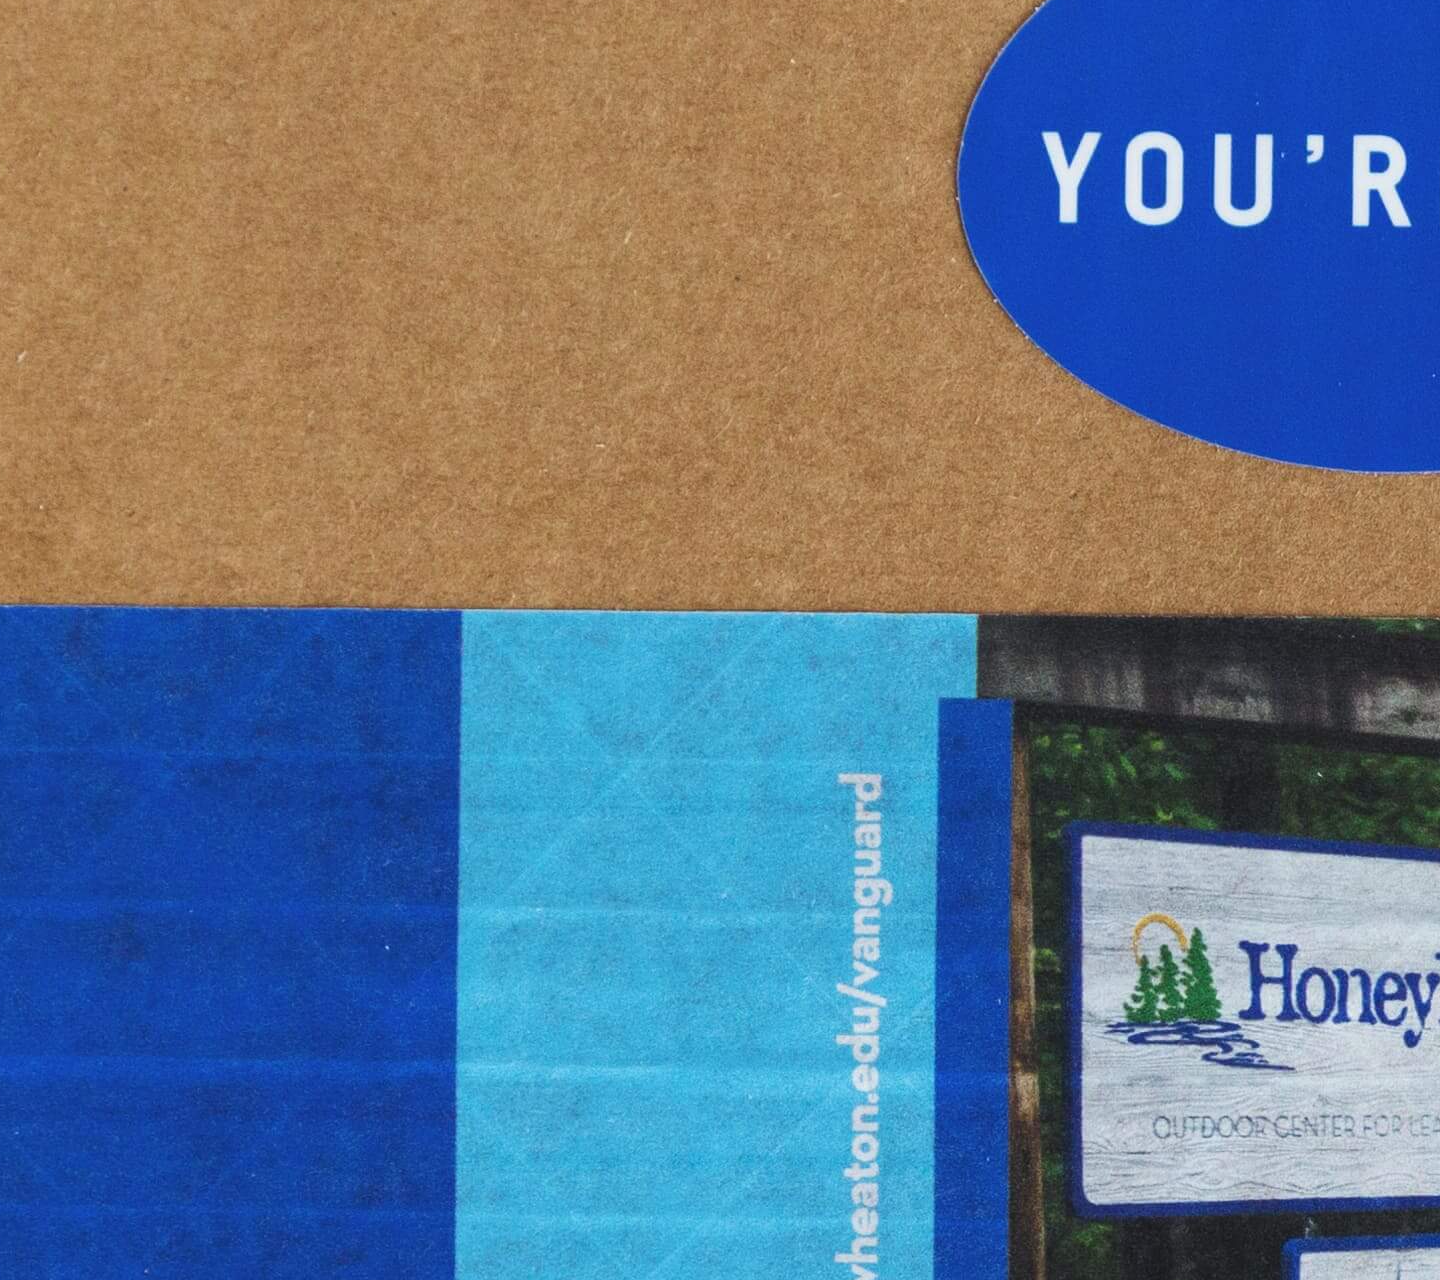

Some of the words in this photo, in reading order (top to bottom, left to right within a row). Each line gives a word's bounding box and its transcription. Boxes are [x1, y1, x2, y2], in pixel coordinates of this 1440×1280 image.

[1152, 1114, 1267, 1140] OUTDOOR
[1274, 1114, 1356, 1139] CENTER
[1363, 1114, 1402, 1139] FOR
